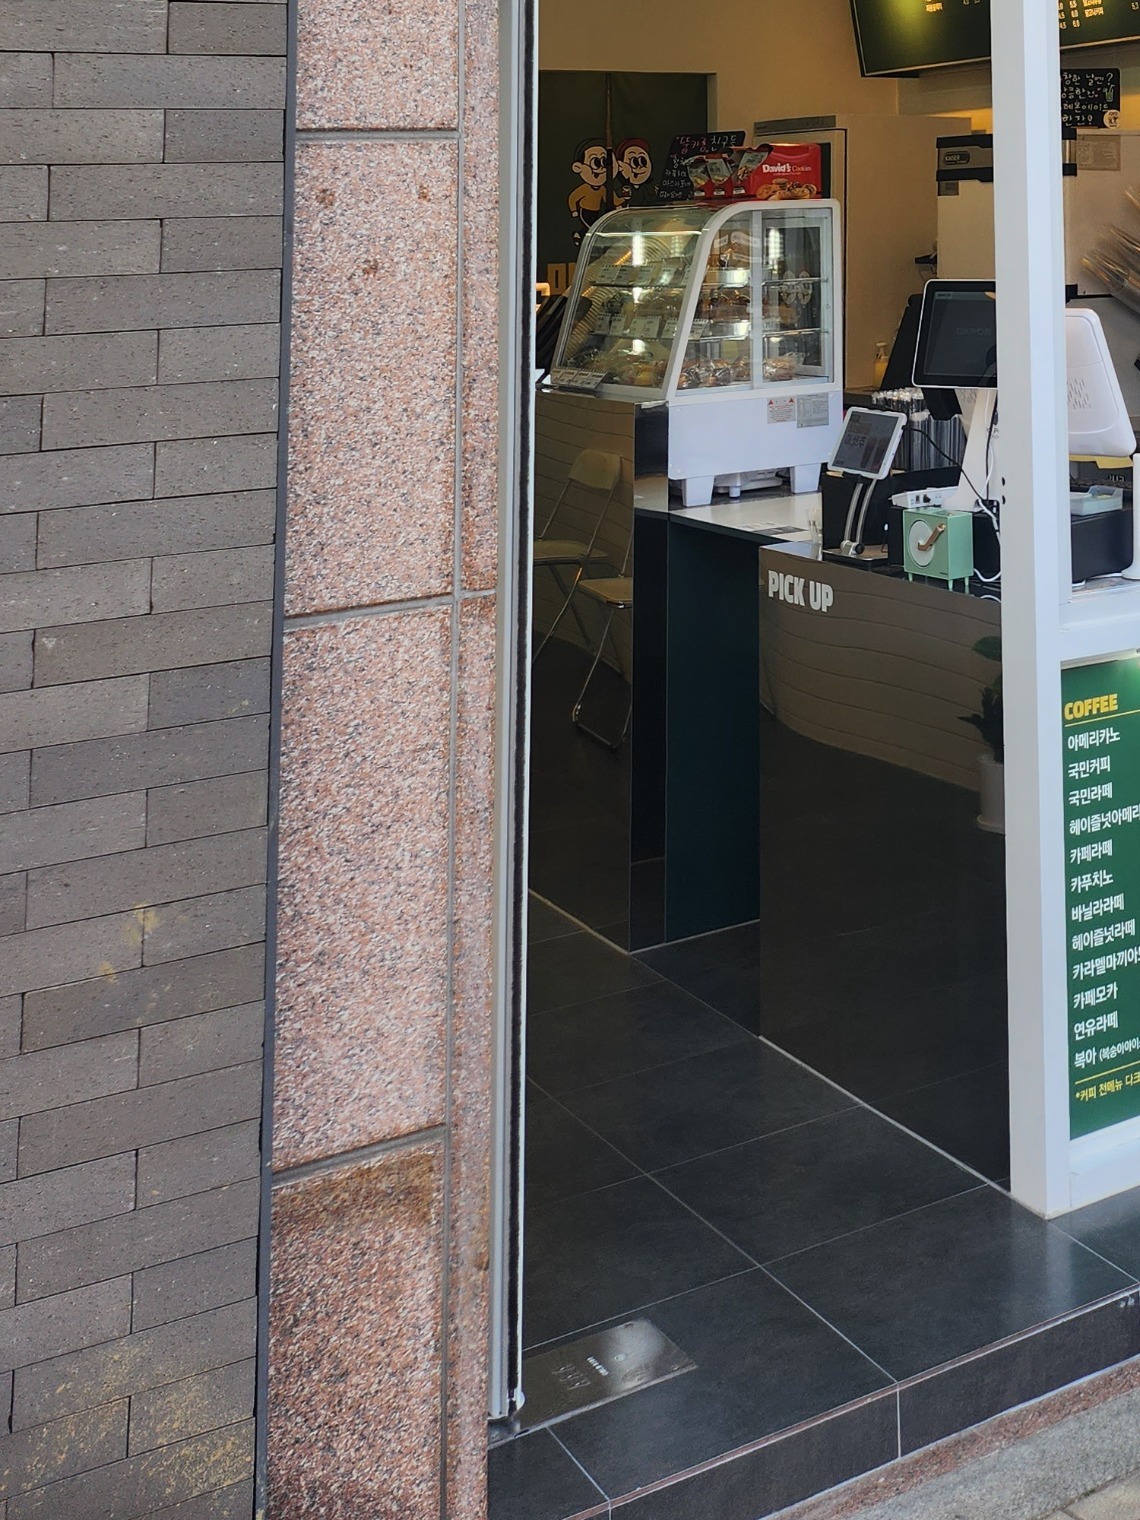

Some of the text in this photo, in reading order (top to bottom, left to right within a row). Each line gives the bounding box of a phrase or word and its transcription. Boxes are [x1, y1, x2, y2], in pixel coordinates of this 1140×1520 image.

[768, 569, 834, 613] PICK UP
[1064, 693, 1119, 720] COFFEE
[1068, 727, 1121, 752] 아메리카노
[1068, 755, 1111, 780] 국민커피
[1068, 781, 1113, 807] 국민라떼
[1070, 838, 1113, 864] 카페라떼
[1071, 869, 1114, 893] 카푸치노
[1071, 892, 1125, 922] 바닐라라떼
[1072, 918, 1136, 951] 헤이즐넛라떼
[1073, 981, 1119, 1009] 카페모카
[1074, 1010, 1119, 1041] 연유라떼
